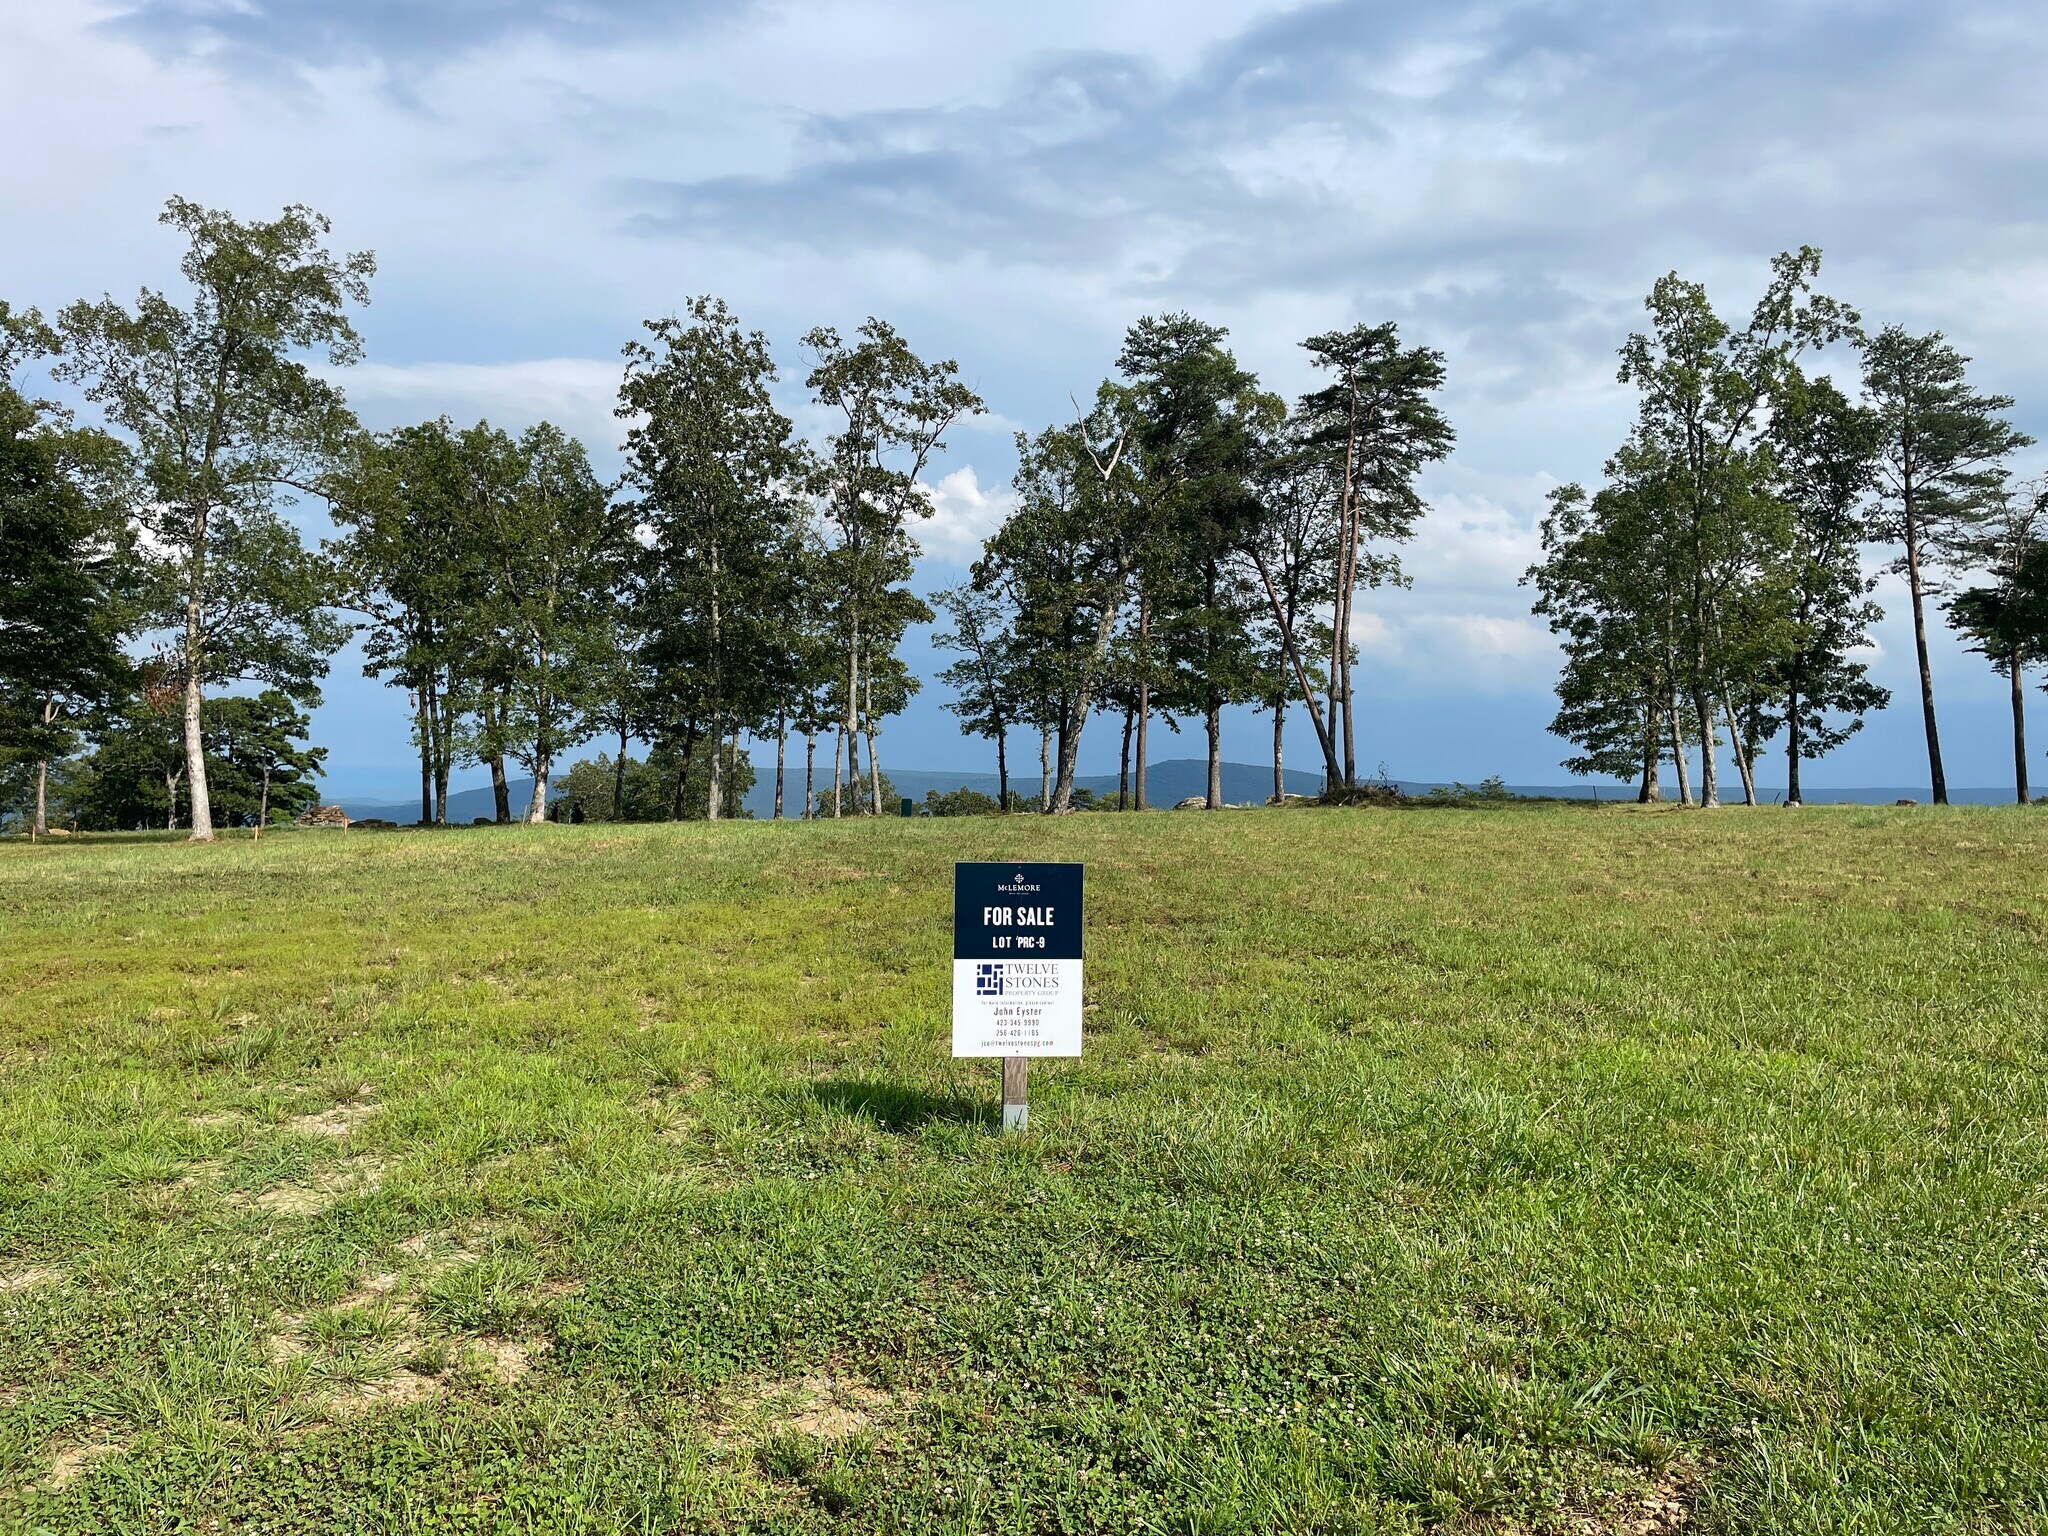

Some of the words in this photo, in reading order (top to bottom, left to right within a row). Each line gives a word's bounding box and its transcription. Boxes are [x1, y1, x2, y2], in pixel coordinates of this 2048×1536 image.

[997, 884, 1041, 892] McLEMORE
[983, 906, 1013, 926] FOR
[1016, 906, 1055, 926] SALE
[992, 936, 1012, 948] LOT
[1005, 963, 1059, 975] TWELVE
[1005, 977, 1059, 988] STONES
[993, 1007, 1013, 1016] John
[1016, 1007, 1042, 1017] Eyster
